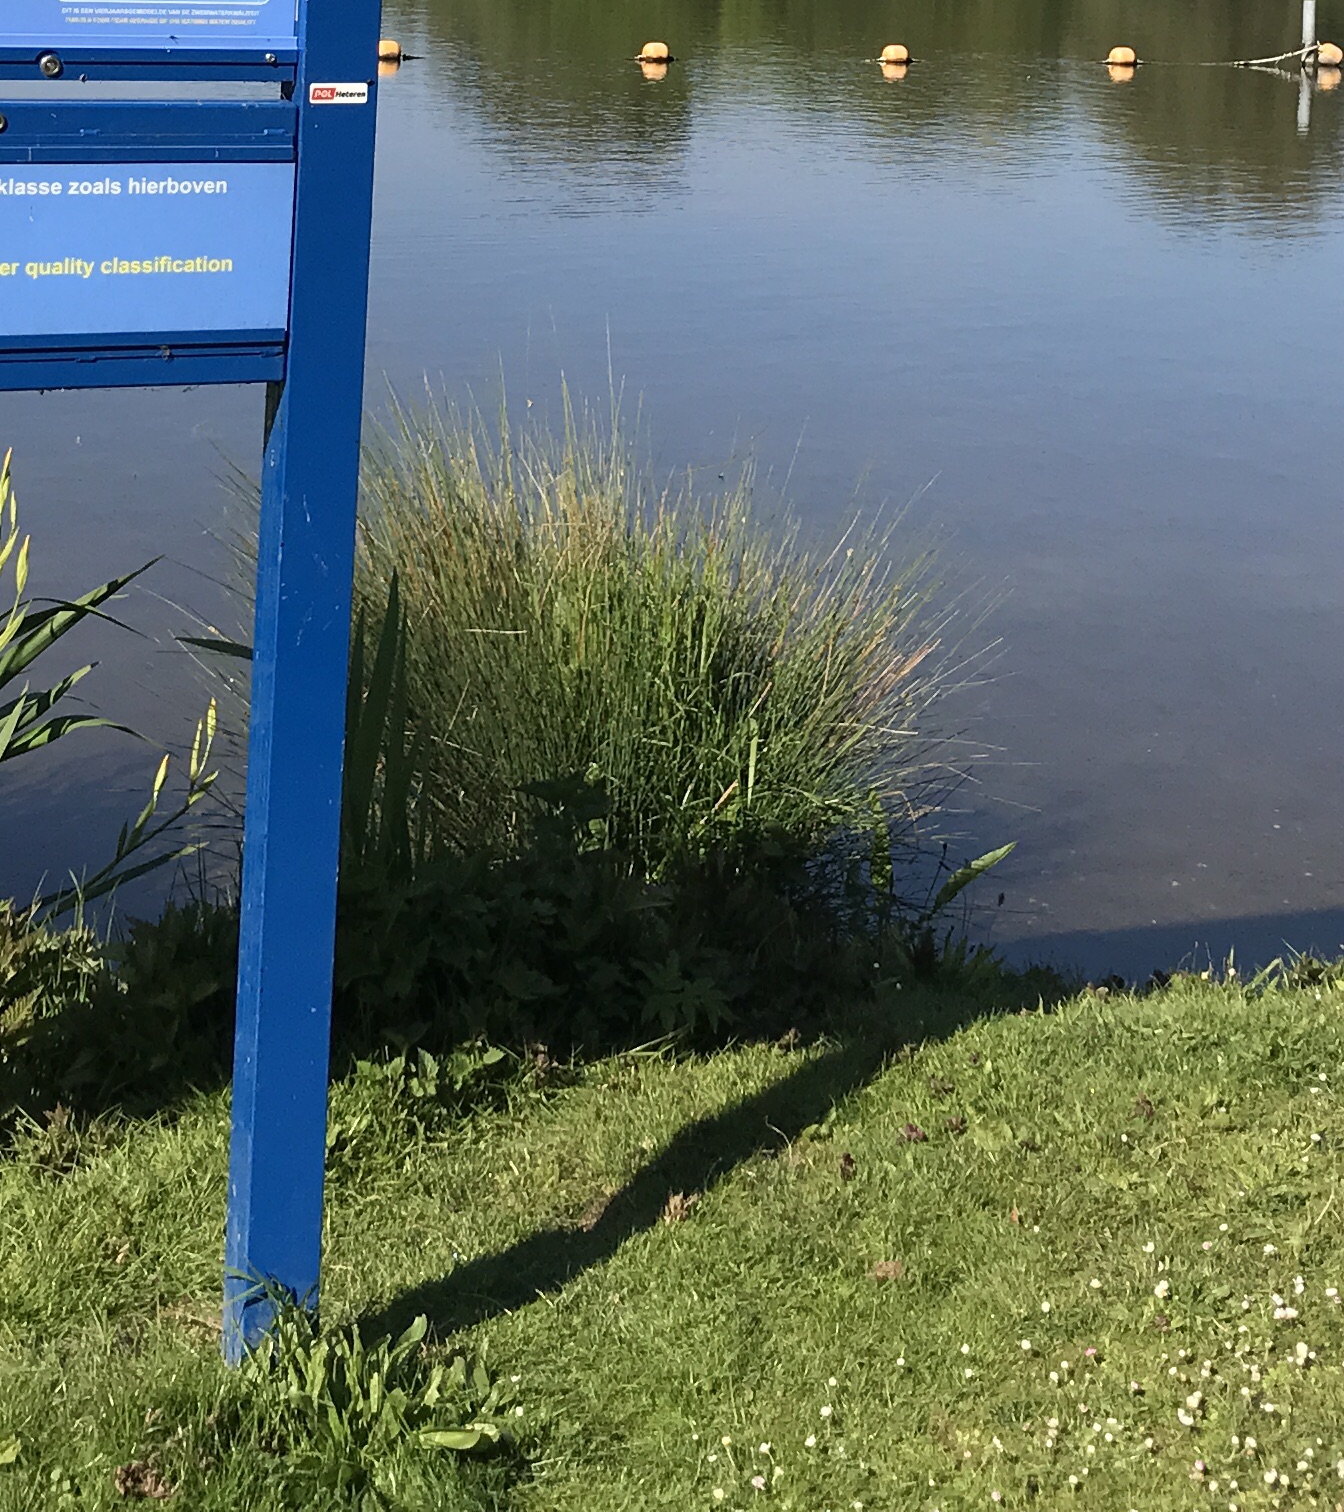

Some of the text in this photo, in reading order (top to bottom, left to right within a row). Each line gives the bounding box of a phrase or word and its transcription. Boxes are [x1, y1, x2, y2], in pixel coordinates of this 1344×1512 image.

[314, 89, 333, 98] POL
[67, 177, 121, 194] zoals
[128, 176, 227, 194] hierboven
[25, 257, 94, 279] quality
[100, 255, 232, 274] classification
